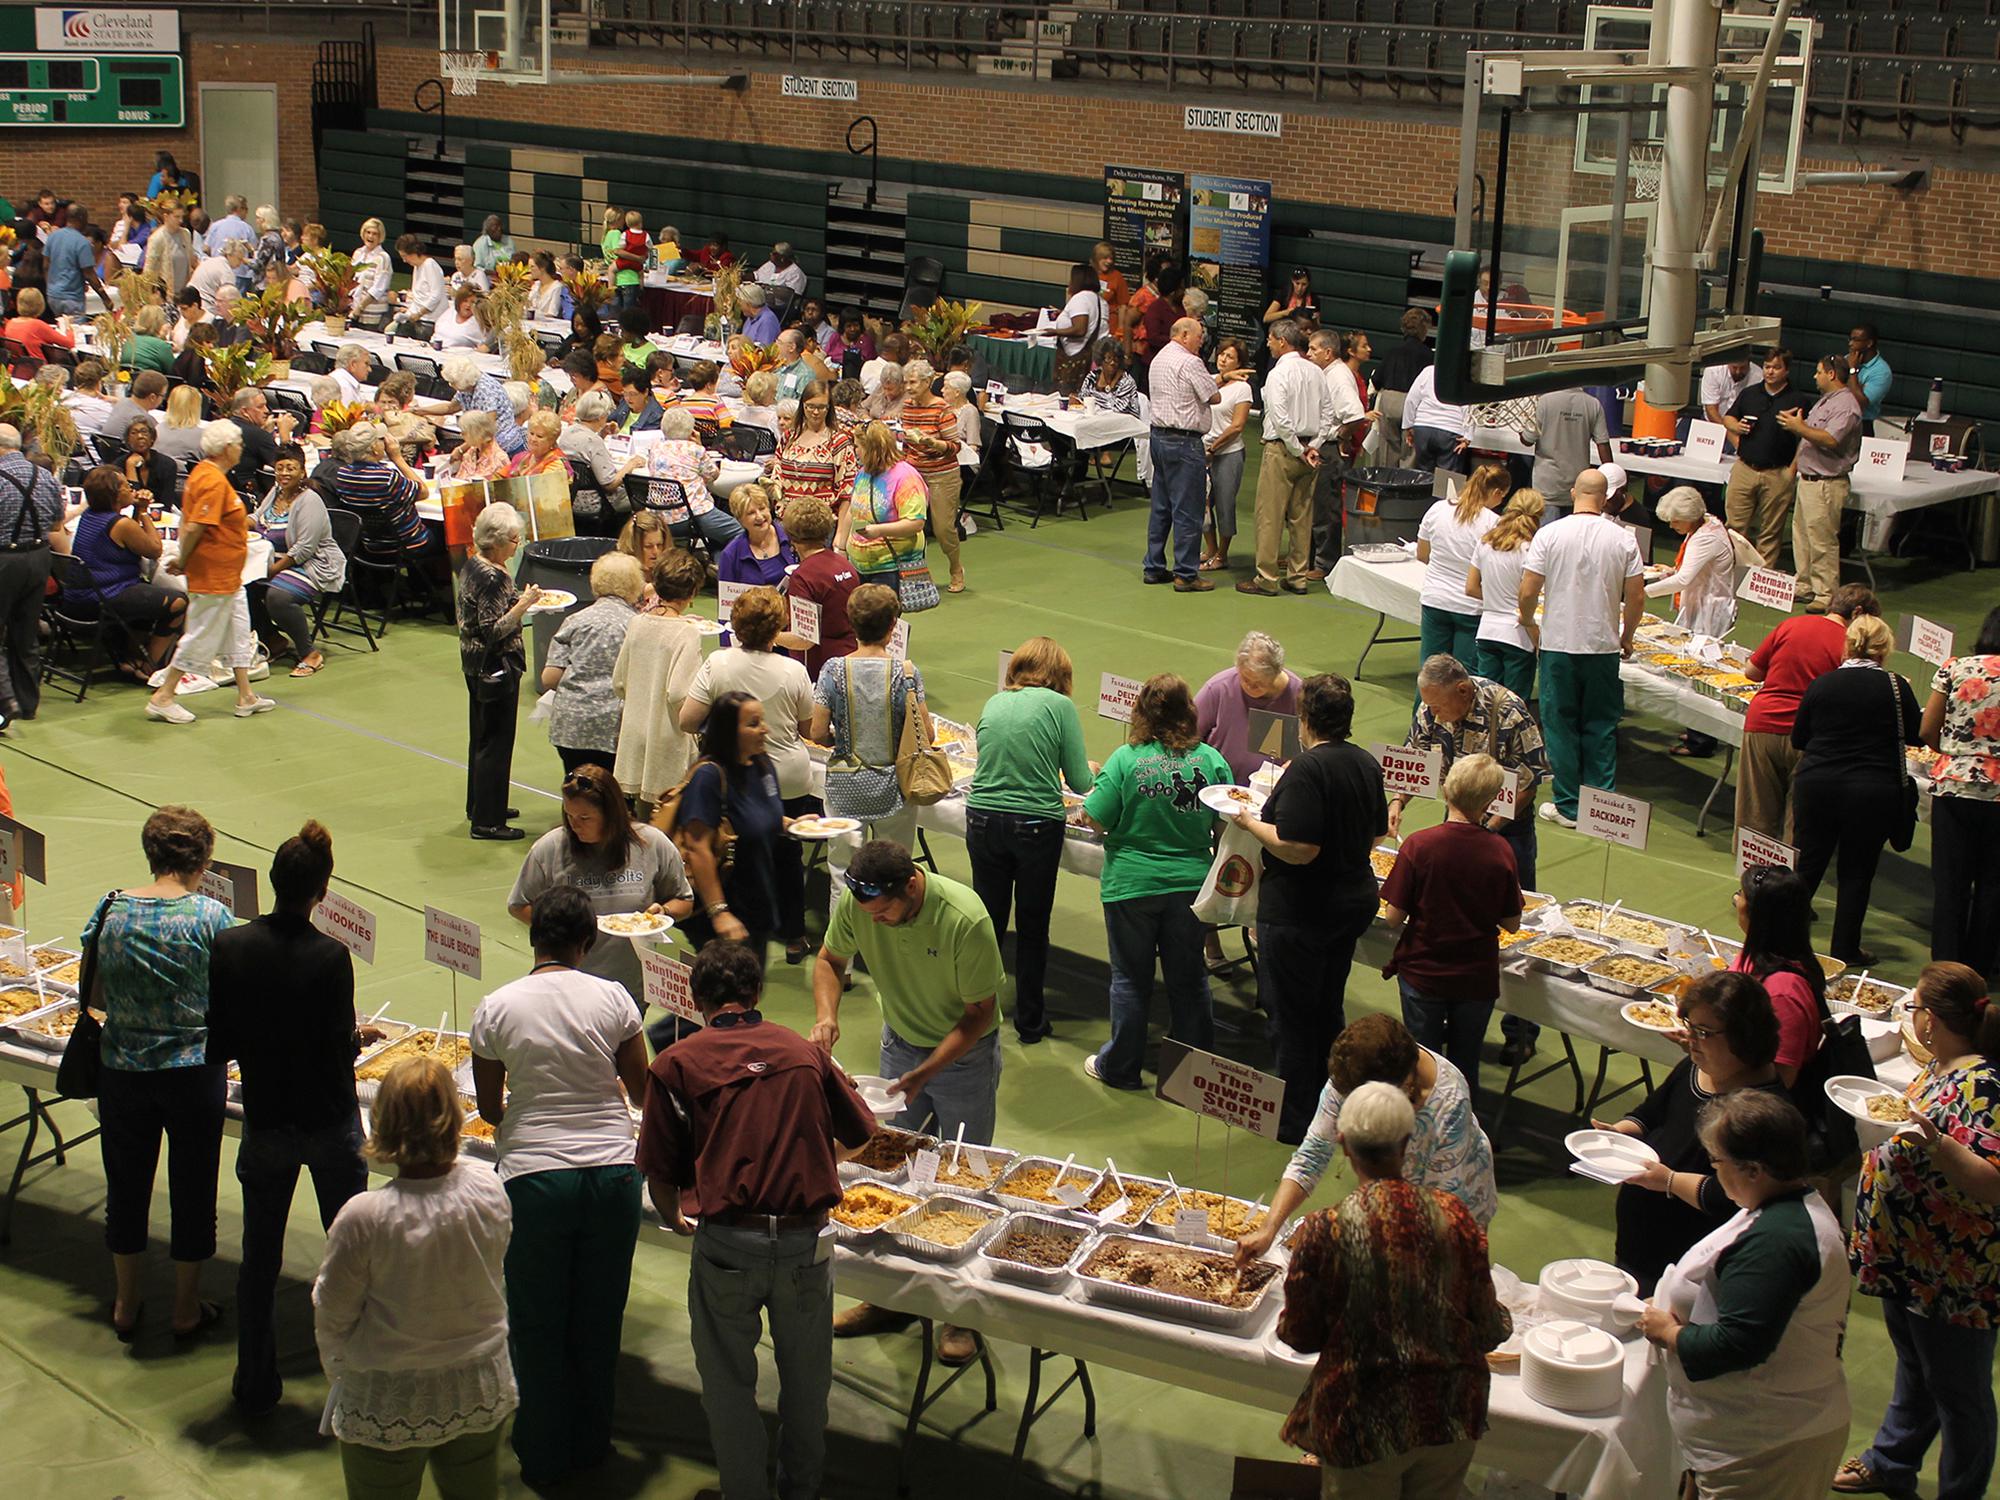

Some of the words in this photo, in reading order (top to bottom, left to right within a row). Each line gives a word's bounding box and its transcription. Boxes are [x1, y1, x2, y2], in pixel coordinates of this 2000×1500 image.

[93, 13, 153, 28] Cleveland
[93, 30, 124, 39] STATE
[126, 31, 154, 39] BANK
[784, 77, 819, 95] STUDENT
[822, 80, 855, 98] SECTION
[67, 92, 88, 102] POSS
[12, 102, 49, 114] PERIOD
[117, 110, 151, 121] BONUS
[1187, 108, 1232, 129] STUDENT
[1235, 112, 1279, 133] SECTION
[1113, 169, 1126, 178] Delta
[1108, 197, 1137, 208] Promoting
[1138, 200, 1149, 208] Rice
[1150, 202, 1176, 212] Produced
[1117, 206, 1126, 214] the
[1127, 207, 1156, 217] Mississippi
[1157, 210, 1173, 219] Delta
[1215, 217, 1243, 228] Mississippi
[1244, 221, 1260, 230] Delta
[1224, 209, 1236, 218] Rice
[1236, 211, 1263, 222] Produced
[1696, 436, 1715, 446] WATER
[1870, 451, 1893, 459] DIET
[1872, 458, 1888, 466] RC
[1751, 571, 1793, 592] Sherman's
[1748, 581, 1793, 602] Restaurant
[795, 612, 817, 627] Market
[797, 621, 815, 633] Place
[1111, 677, 1139, 691] Furnished
[1101, 693, 1122, 704] MEAT
[1385, 745, 1417, 757] Furnished
[1418, 750, 1427, 758] By
[1382, 755, 1427, 774] Dave
[1410, 783, 1421, 794] MS
[1592, 793, 1625, 810] Furnished
[1626, 803, 1637, 814] By
[1589, 807, 1637, 829] BACKDRAFT
[1620, 832, 1630, 841] MS
[1742, 839, 1789, 865] BOLIVAR
[566, 871, 602, 891] Lady
[604, 869, 644, 886] Colts
[325, 895, 355, 914] urnished
[357, 908, 367, 923] By
[318, 903, 372, 942] SNOOKIES
[433, 913, 461, 932] Furnished
[463, 925, 472, 937] By
[352, 942, 362, 952] MS
[427, 928, 439, 944] THE
[440, 933, 456, 950] BLUE
[456, 940, 480, 960] BISCUIT
[645, 959, 690, 986] Sunflow
[648, 983, 678, 1003] Store
[661, 977, 687, 996] Food
[1210, 1056, 1250, 1078] Furnished
[1251, 1071, 1264, 1084] By
[1218, 1071, 1254, 1094] The
[1192, 1075, 1276, 1116] Onward
[1202, 1091, 1262, 1121] Store
[1202, 1104, 1227, 1119] Rolling
[1248, 1120, 1262, 1133] MS
